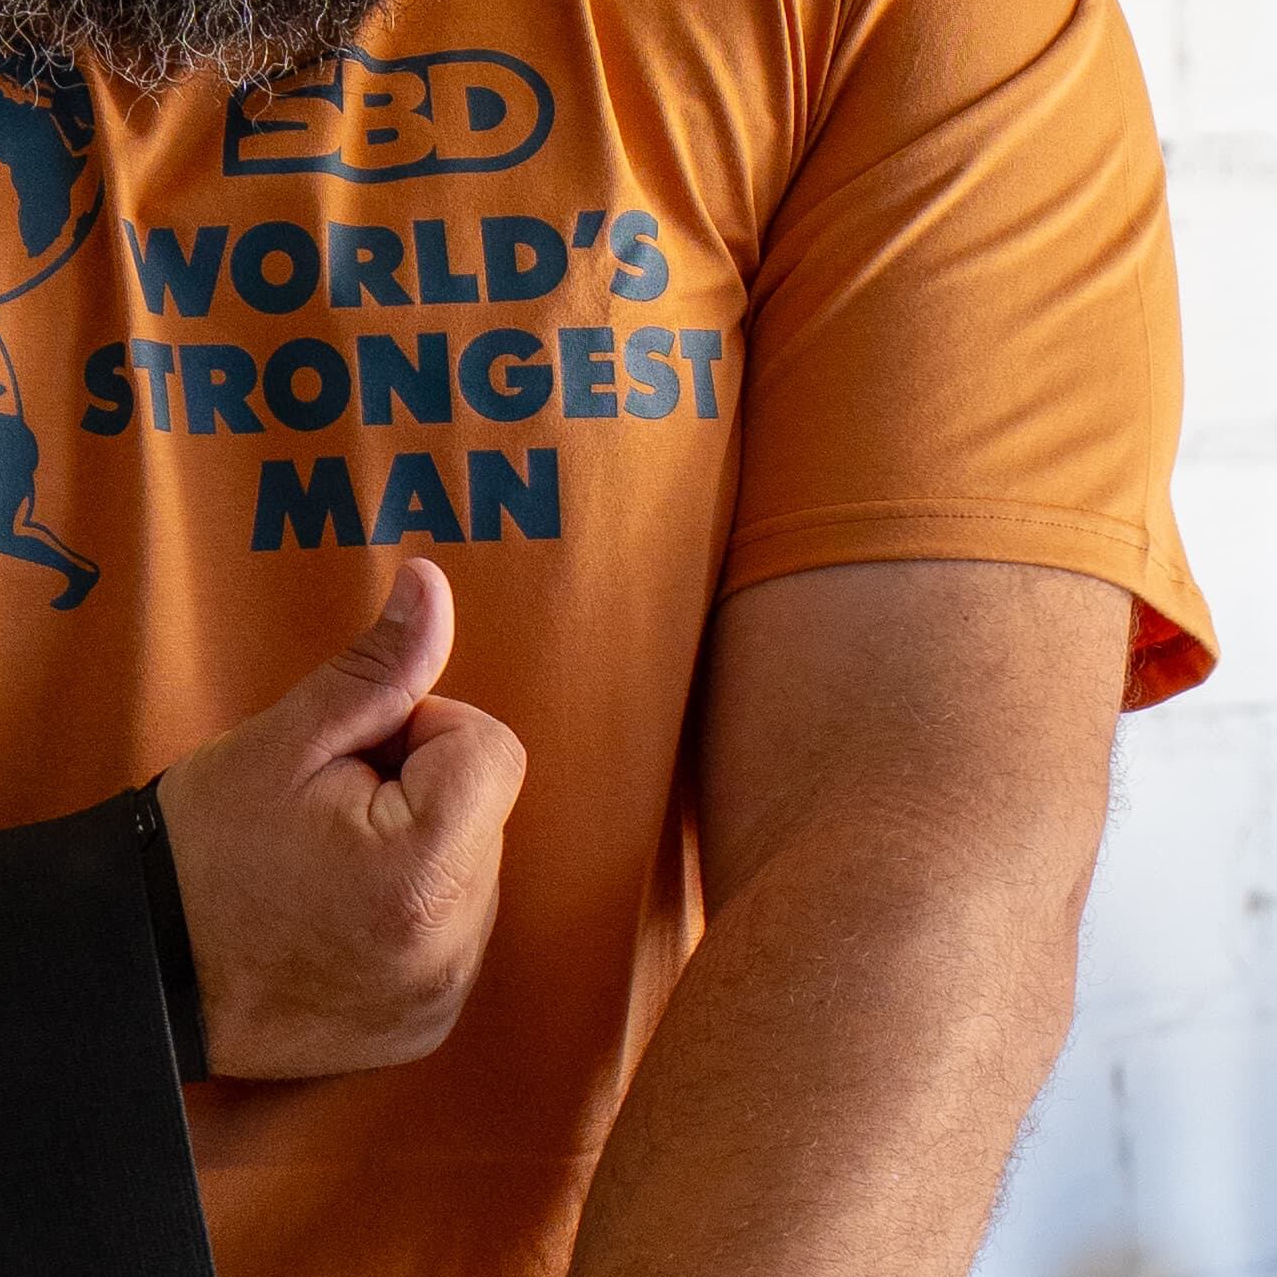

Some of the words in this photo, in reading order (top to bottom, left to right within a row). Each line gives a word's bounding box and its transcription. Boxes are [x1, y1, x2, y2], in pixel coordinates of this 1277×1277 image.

[225, 48, 553, 182] SBD
[123, 210, 669, 318] WORLD'S
[80, 326, 722, 436] STRONGEST
[251, 448, 562, 552] MAN
